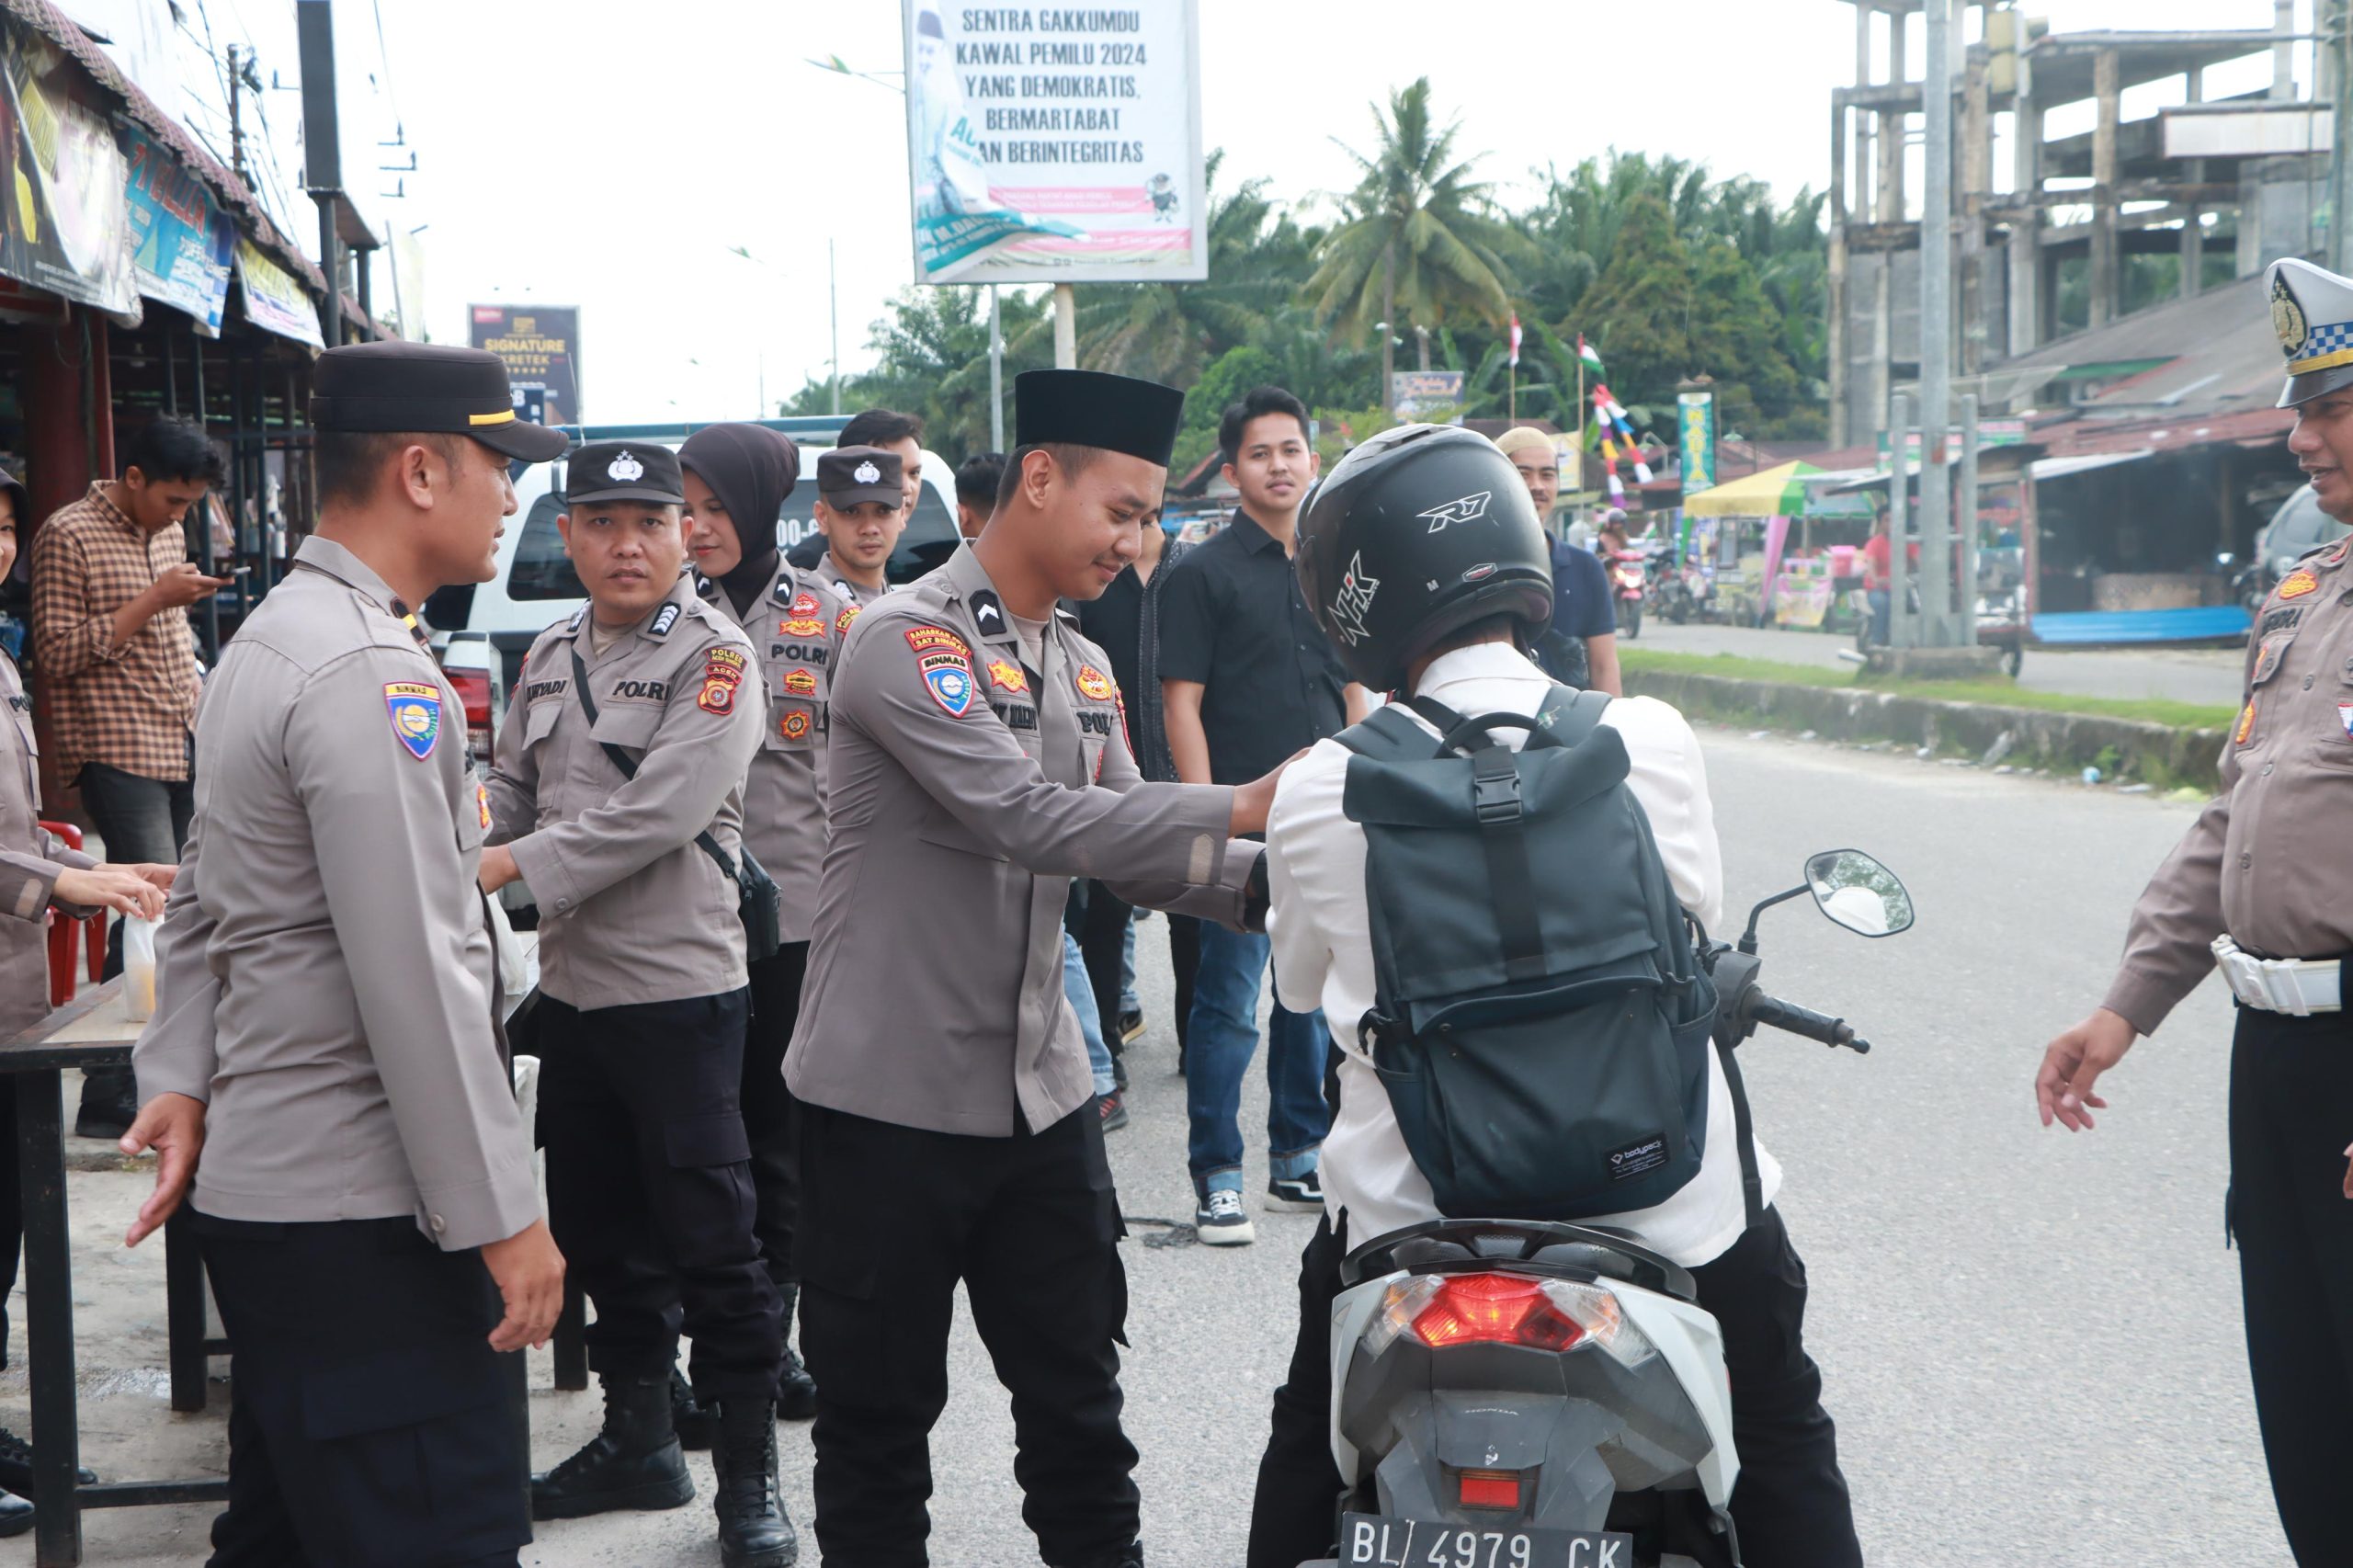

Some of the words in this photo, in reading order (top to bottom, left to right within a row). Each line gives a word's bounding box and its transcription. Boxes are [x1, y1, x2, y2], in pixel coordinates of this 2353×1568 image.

[962, 9, 1033, 32] SENTRA
[1040, 9, 1140, 33] GAKKUMDU
[956, 42, 1024, 65] KAWAL
[1030, 42, 1095, 65] PEMILU
[1100, 43, 1147, 65] 2024
[965, 74, 1016, 97] YANG
[1021, 75, 1141, 99] DEMOKRATIS,
[986, 108, 1120, 131] BERMARTABAT
[979, 141, 1002, 164] AN
[1008, 141, 1143, 164] BERINTEGRITAS
[484, 338, 565, 353] SIGNATURE
[1427, 579, 1439, 592] M
[710, 649, 744, 664] POLRES
[771, 643, 827, 665] POLRI
[915, 637, 934, 647] SAT
[934, 637, 968, 655] BINMAS
[924, 654, 966, 668] BINMAS
[712, 666, 737, 678] ACEH
[612, 680, 671, 701] POLRI
[1623, 1140, 1663, 1159] bodypack
[1352, 1521, 1400, 1566] BL
[1427, 1530, 1531, 1568] 4979
[1568, 1538, 1621, 1568] CK
